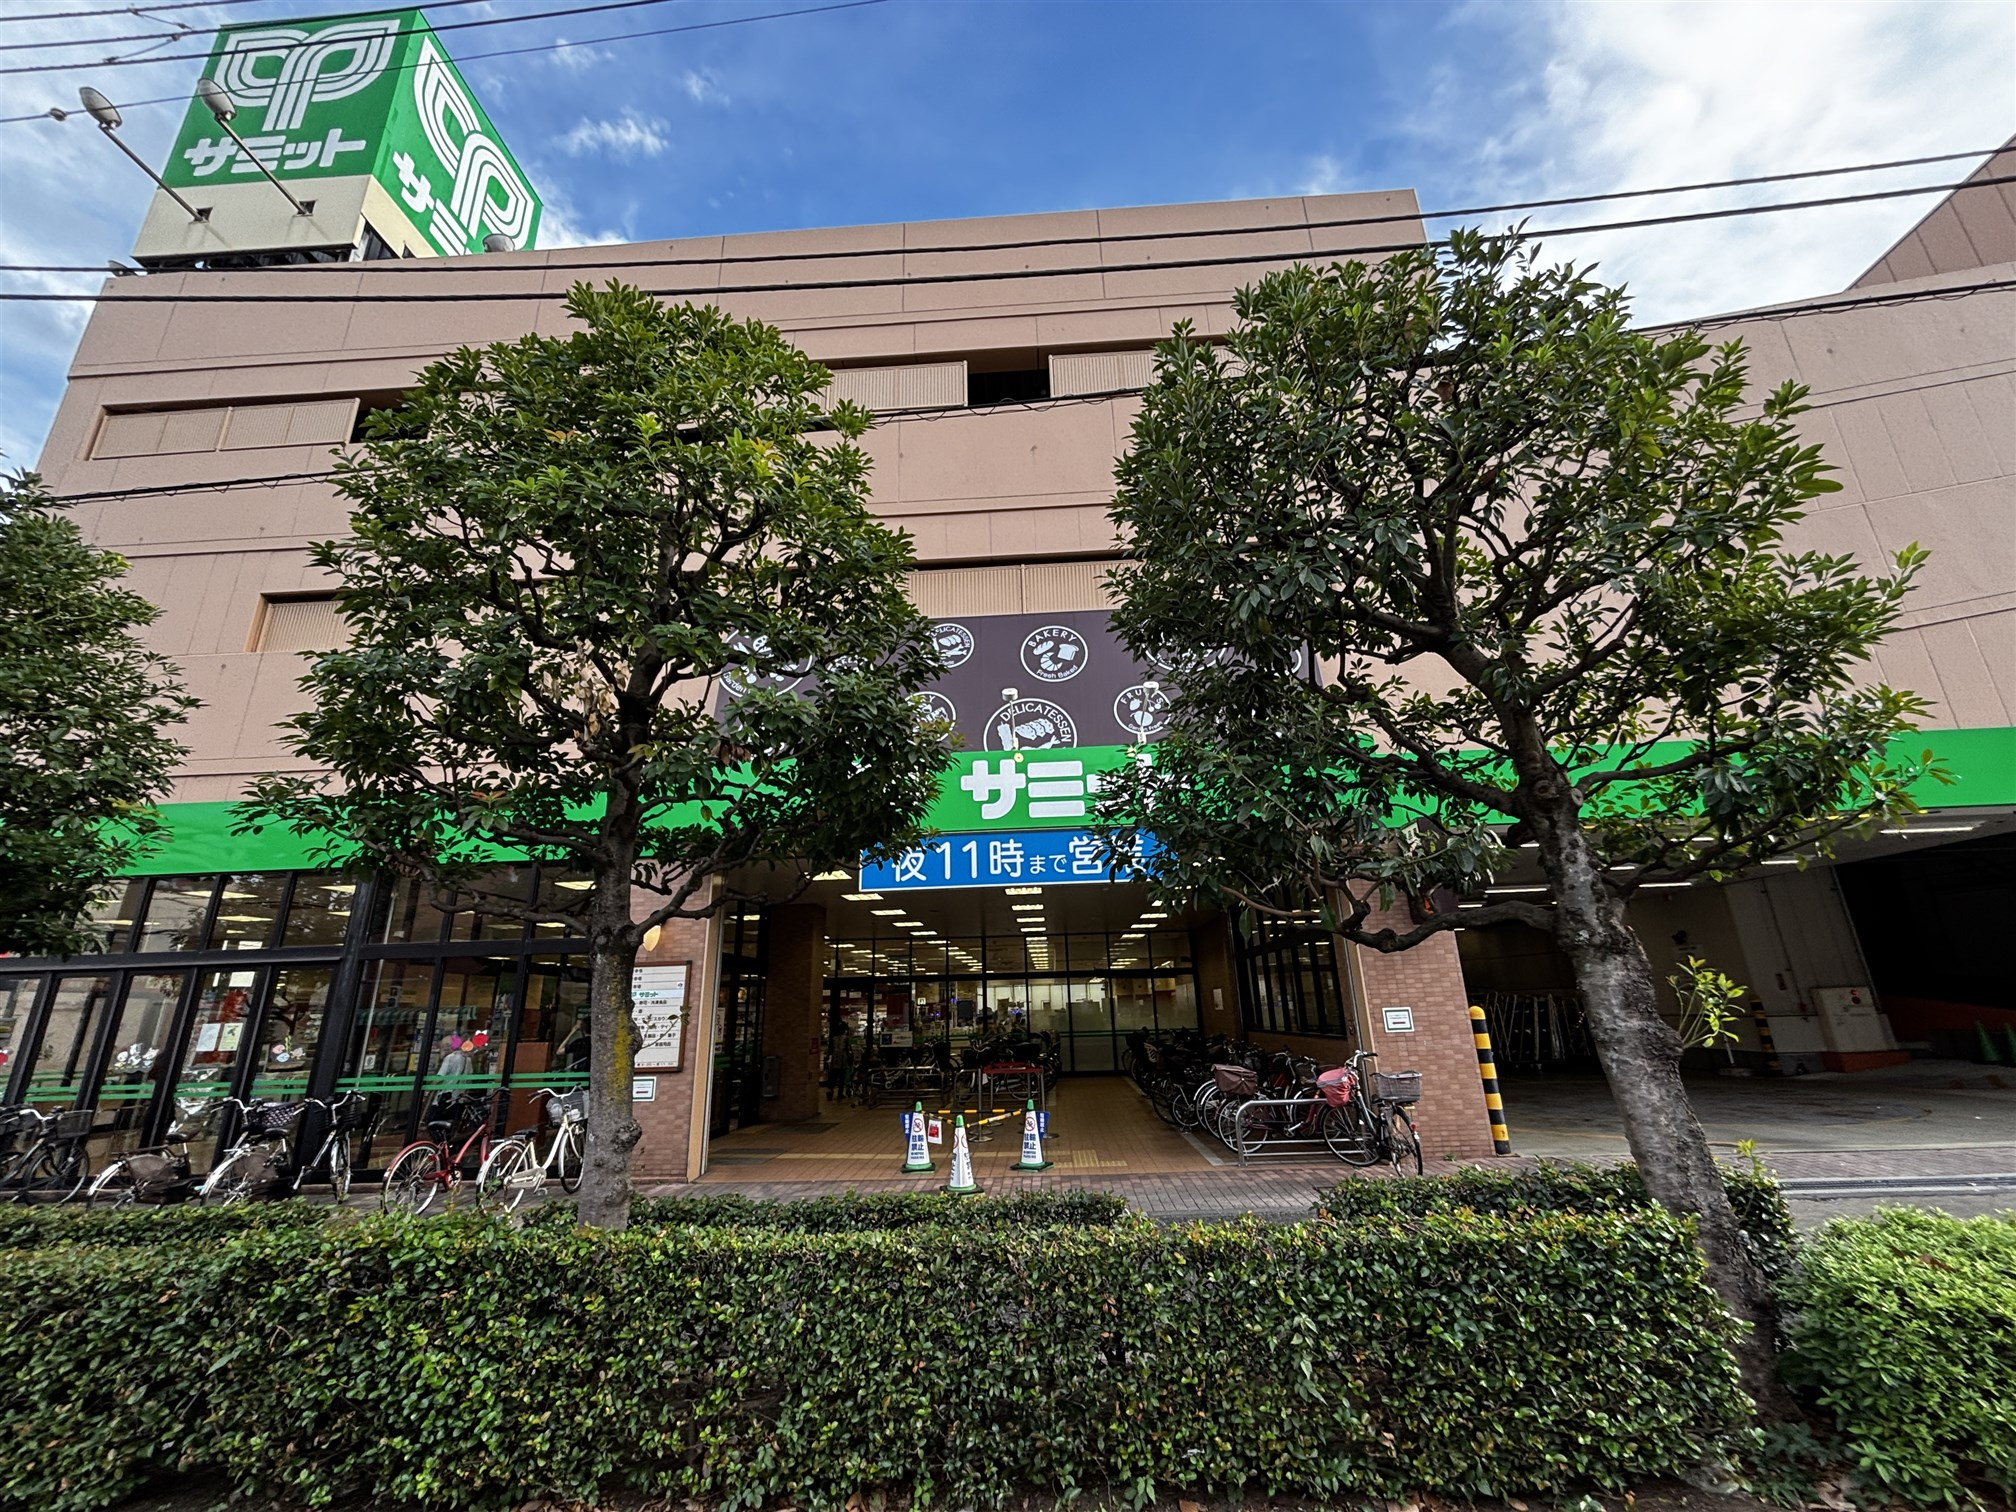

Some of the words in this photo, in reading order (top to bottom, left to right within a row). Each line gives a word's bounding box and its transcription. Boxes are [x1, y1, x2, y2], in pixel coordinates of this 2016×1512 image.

[183, 127, 366, 177] サミット
[1027, 628, 1077, 648] BAKERY
[1036, 669, 1057, 679] Fresh
[1057, 665, 1078, 679] Baked
[1000, 702, 1072, 743] DELICATESSEN
